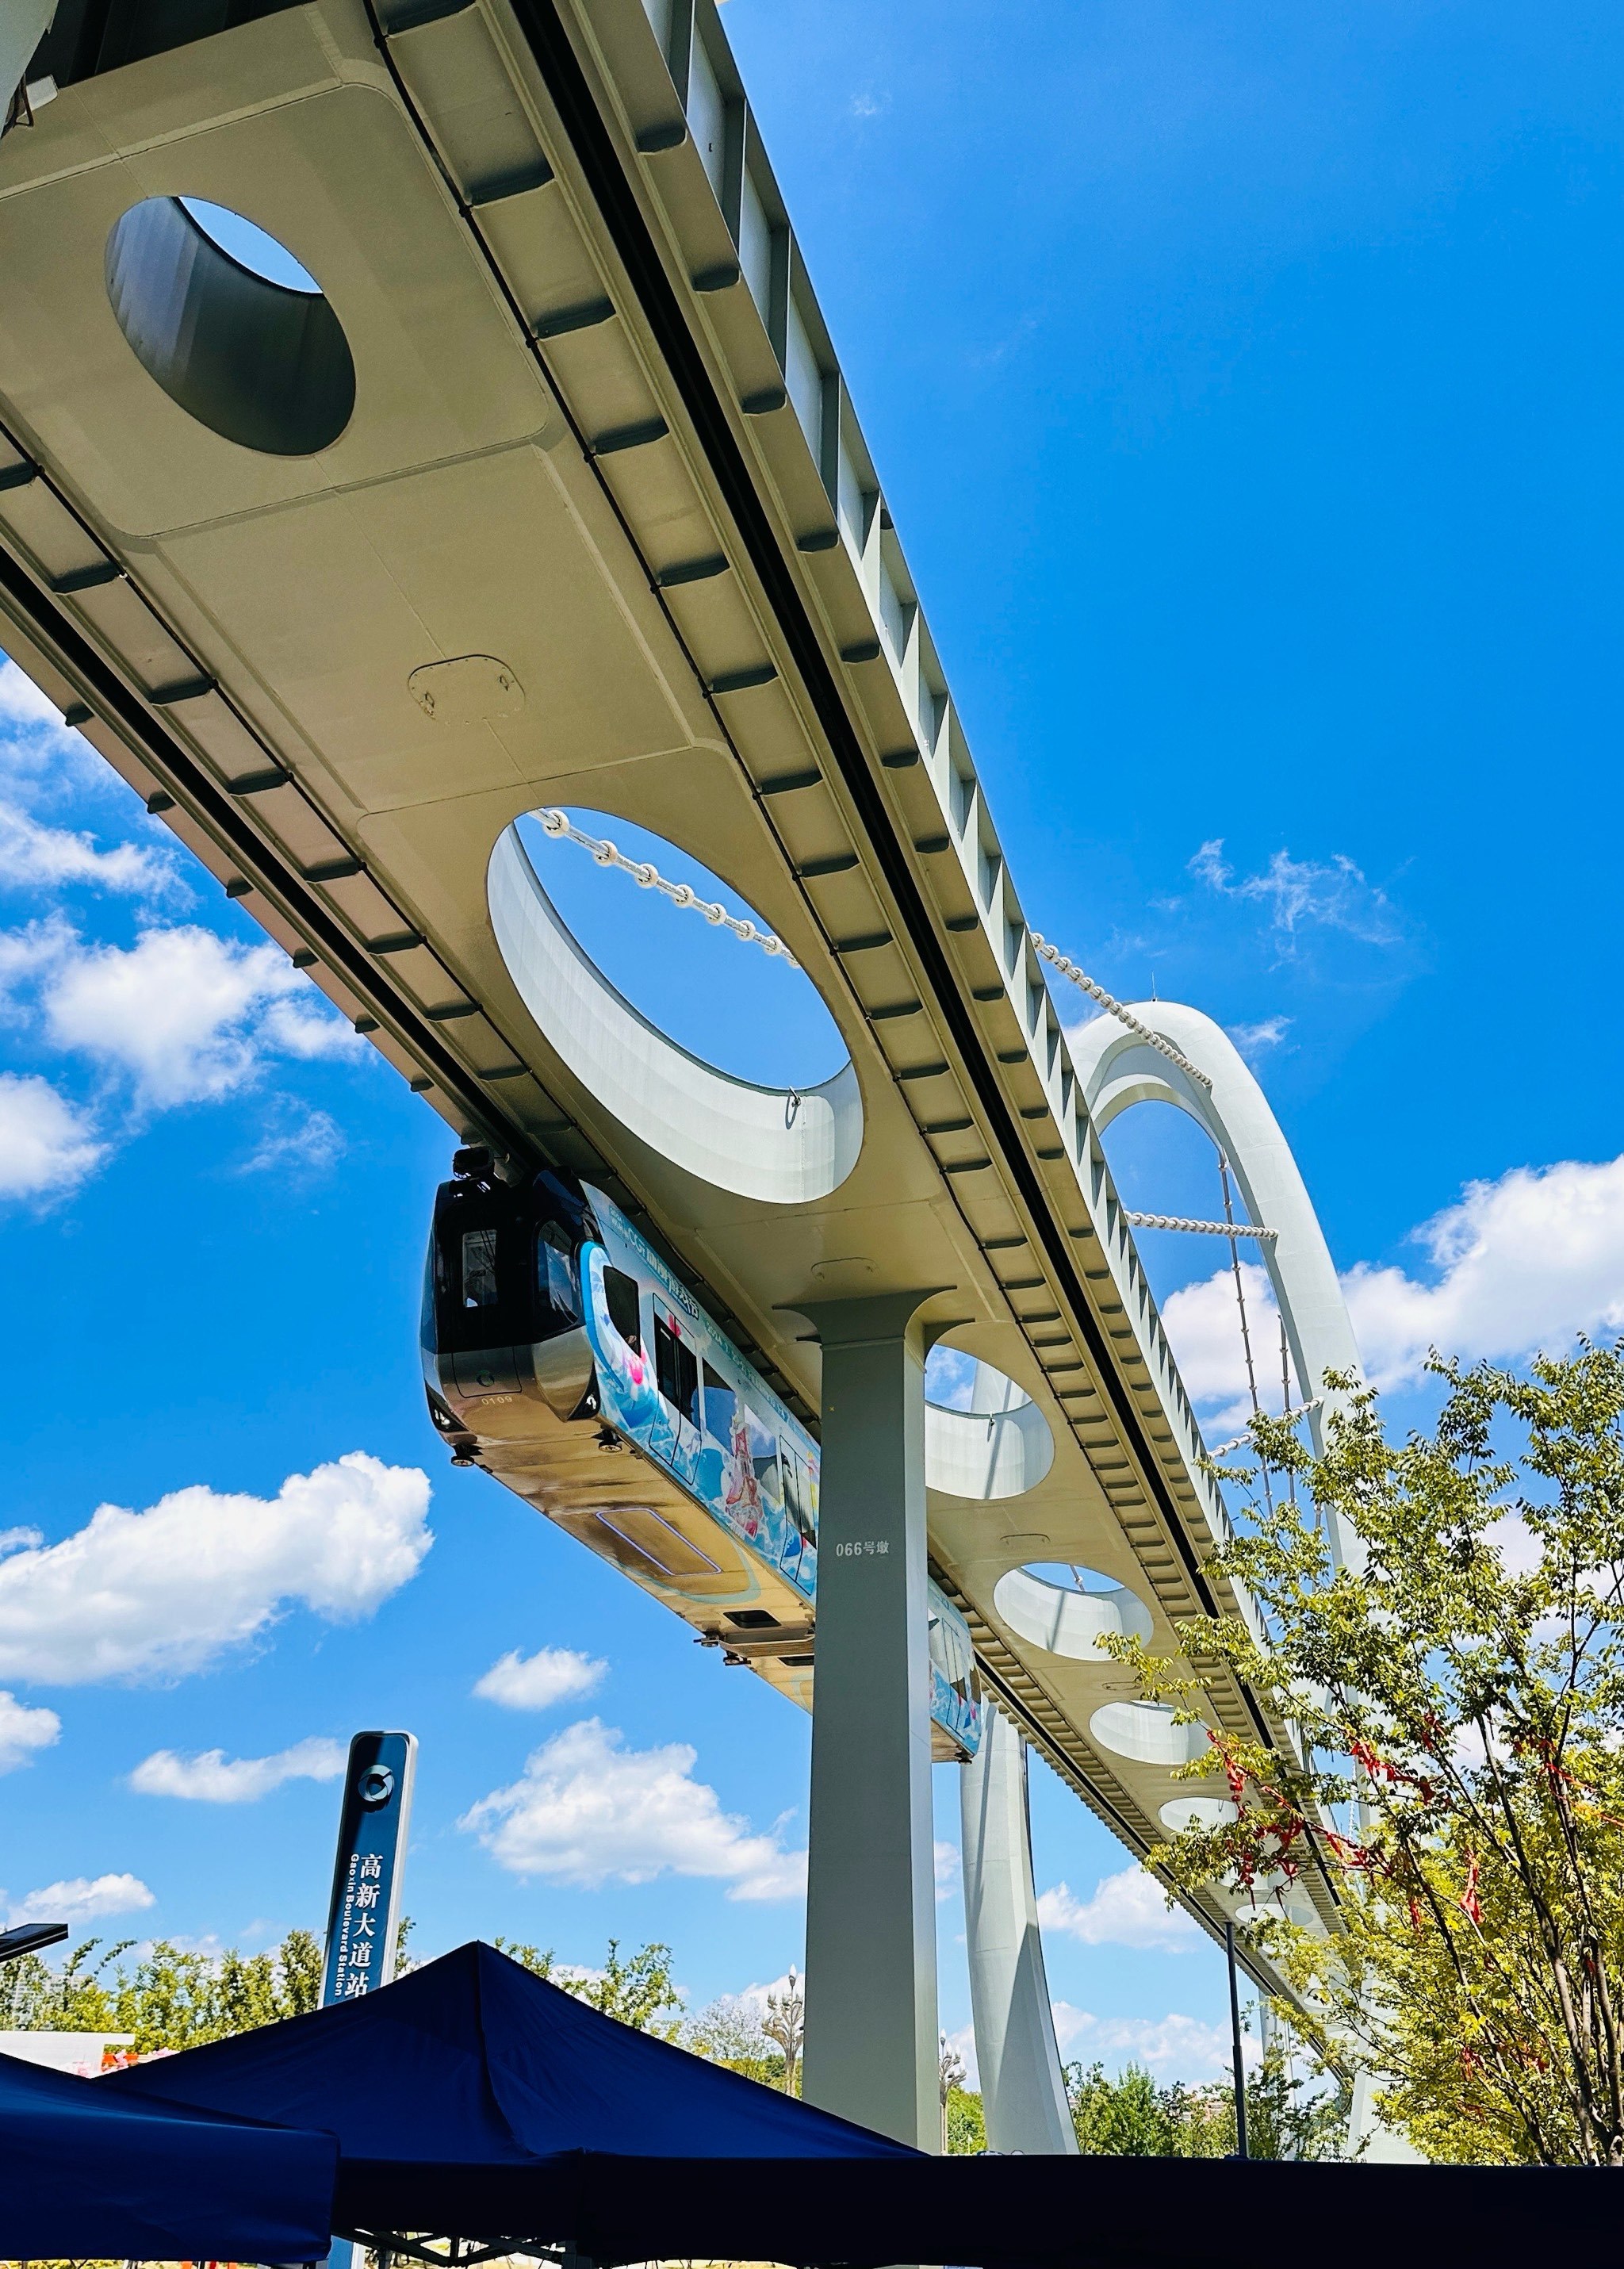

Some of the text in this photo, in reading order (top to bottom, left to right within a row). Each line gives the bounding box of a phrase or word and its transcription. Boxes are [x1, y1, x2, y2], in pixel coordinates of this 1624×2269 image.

[481, 1395, 512, 1405] 0109
[836, 1540, 890, 1557] 066号墩
[334, 1853, 360, 1996] Gaoxin Boulevard Station
[344, 1853, 384, 1998] 高新大道站
